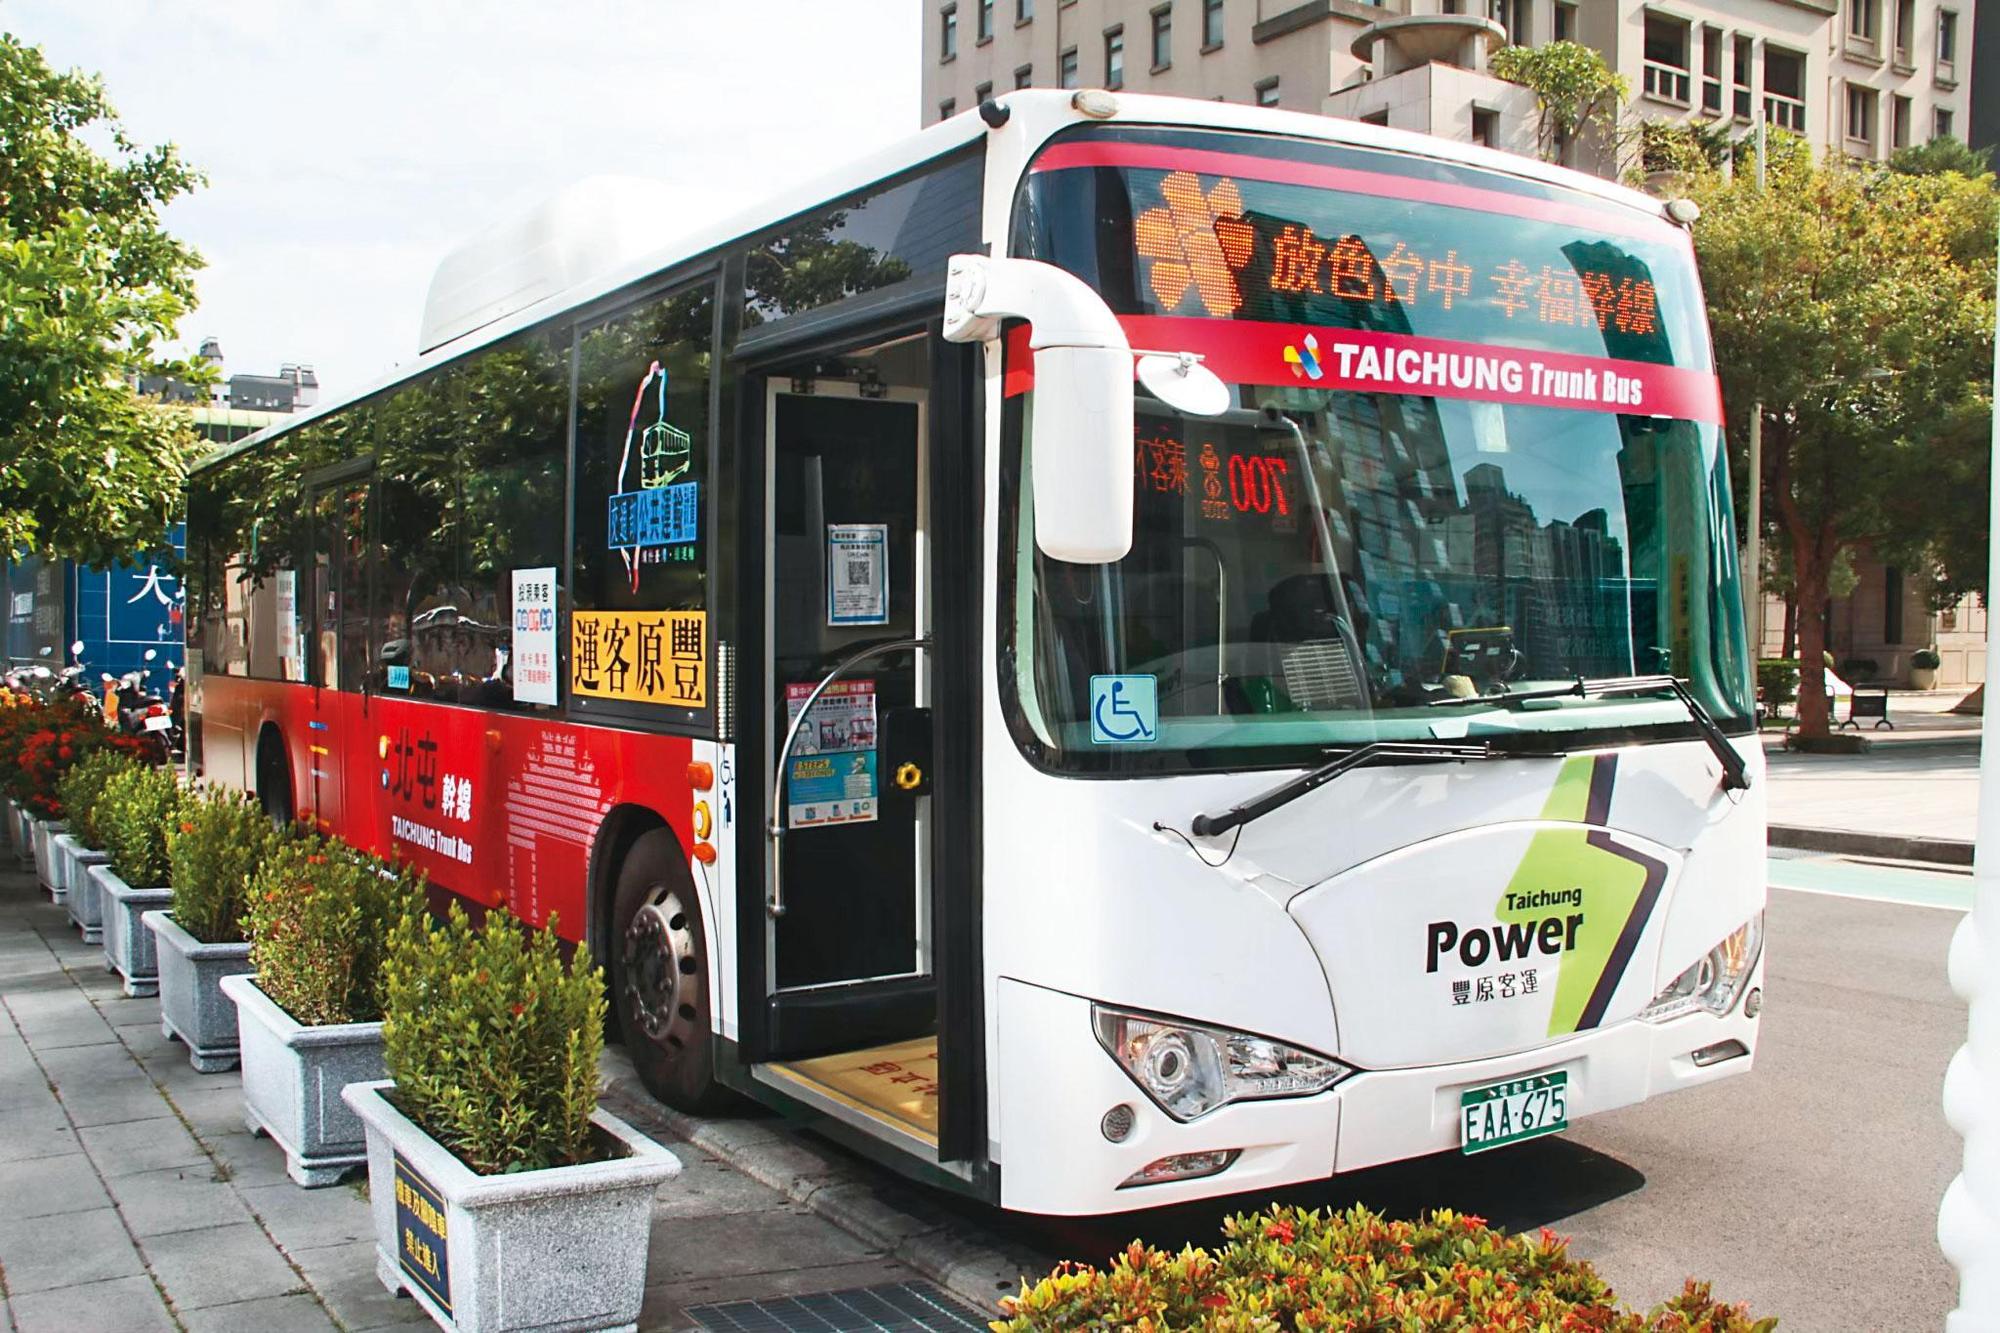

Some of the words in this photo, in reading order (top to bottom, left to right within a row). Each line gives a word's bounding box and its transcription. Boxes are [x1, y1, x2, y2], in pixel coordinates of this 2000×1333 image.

[1489, 259, 1656, 335] 幸福幹線
[1333, 343, 1523, 393] TAICHUNG
[1530, 363, 1597, 401] Trunk
[1603, 371, 1643, 405] Bus
[391, 815, 435, 850] TAICHUNG
[436, 831, 457, 858] Trunk
[457, 838, 473, 864] Bus
[1506, 888, 1582, 911] Taichung
[1426, 912, 1584, 973] Power
[1451, 969, 1539, 1006] 豐原客運
